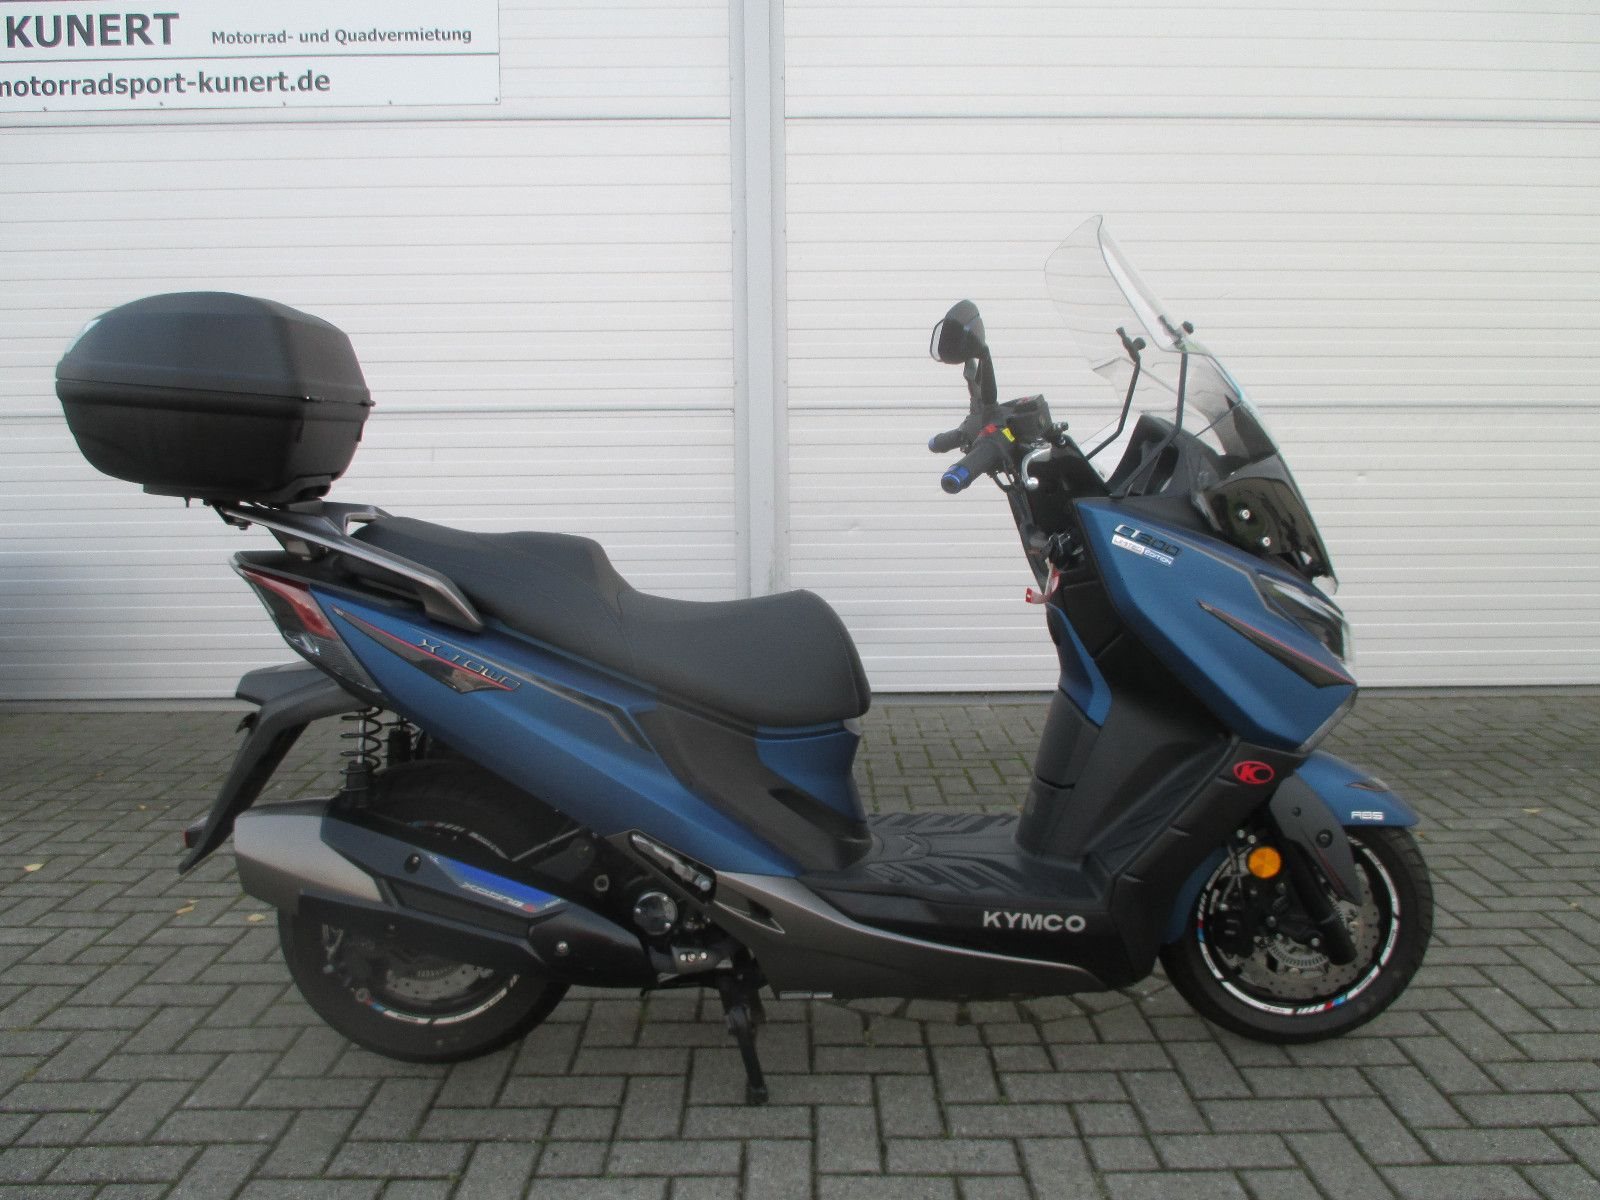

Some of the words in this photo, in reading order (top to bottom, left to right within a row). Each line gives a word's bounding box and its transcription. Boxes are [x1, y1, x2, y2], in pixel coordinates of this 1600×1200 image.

[5, 12, 180, 49] KUNERT
[211, 30, 294, 45] Motorrad-
[299, 29, 330, 44] und
[334, 27, 473, 45] Quadvermietung
[1351, 811, 1384, 820] ABS
[983, 910, 1086, 932] KYMCO
